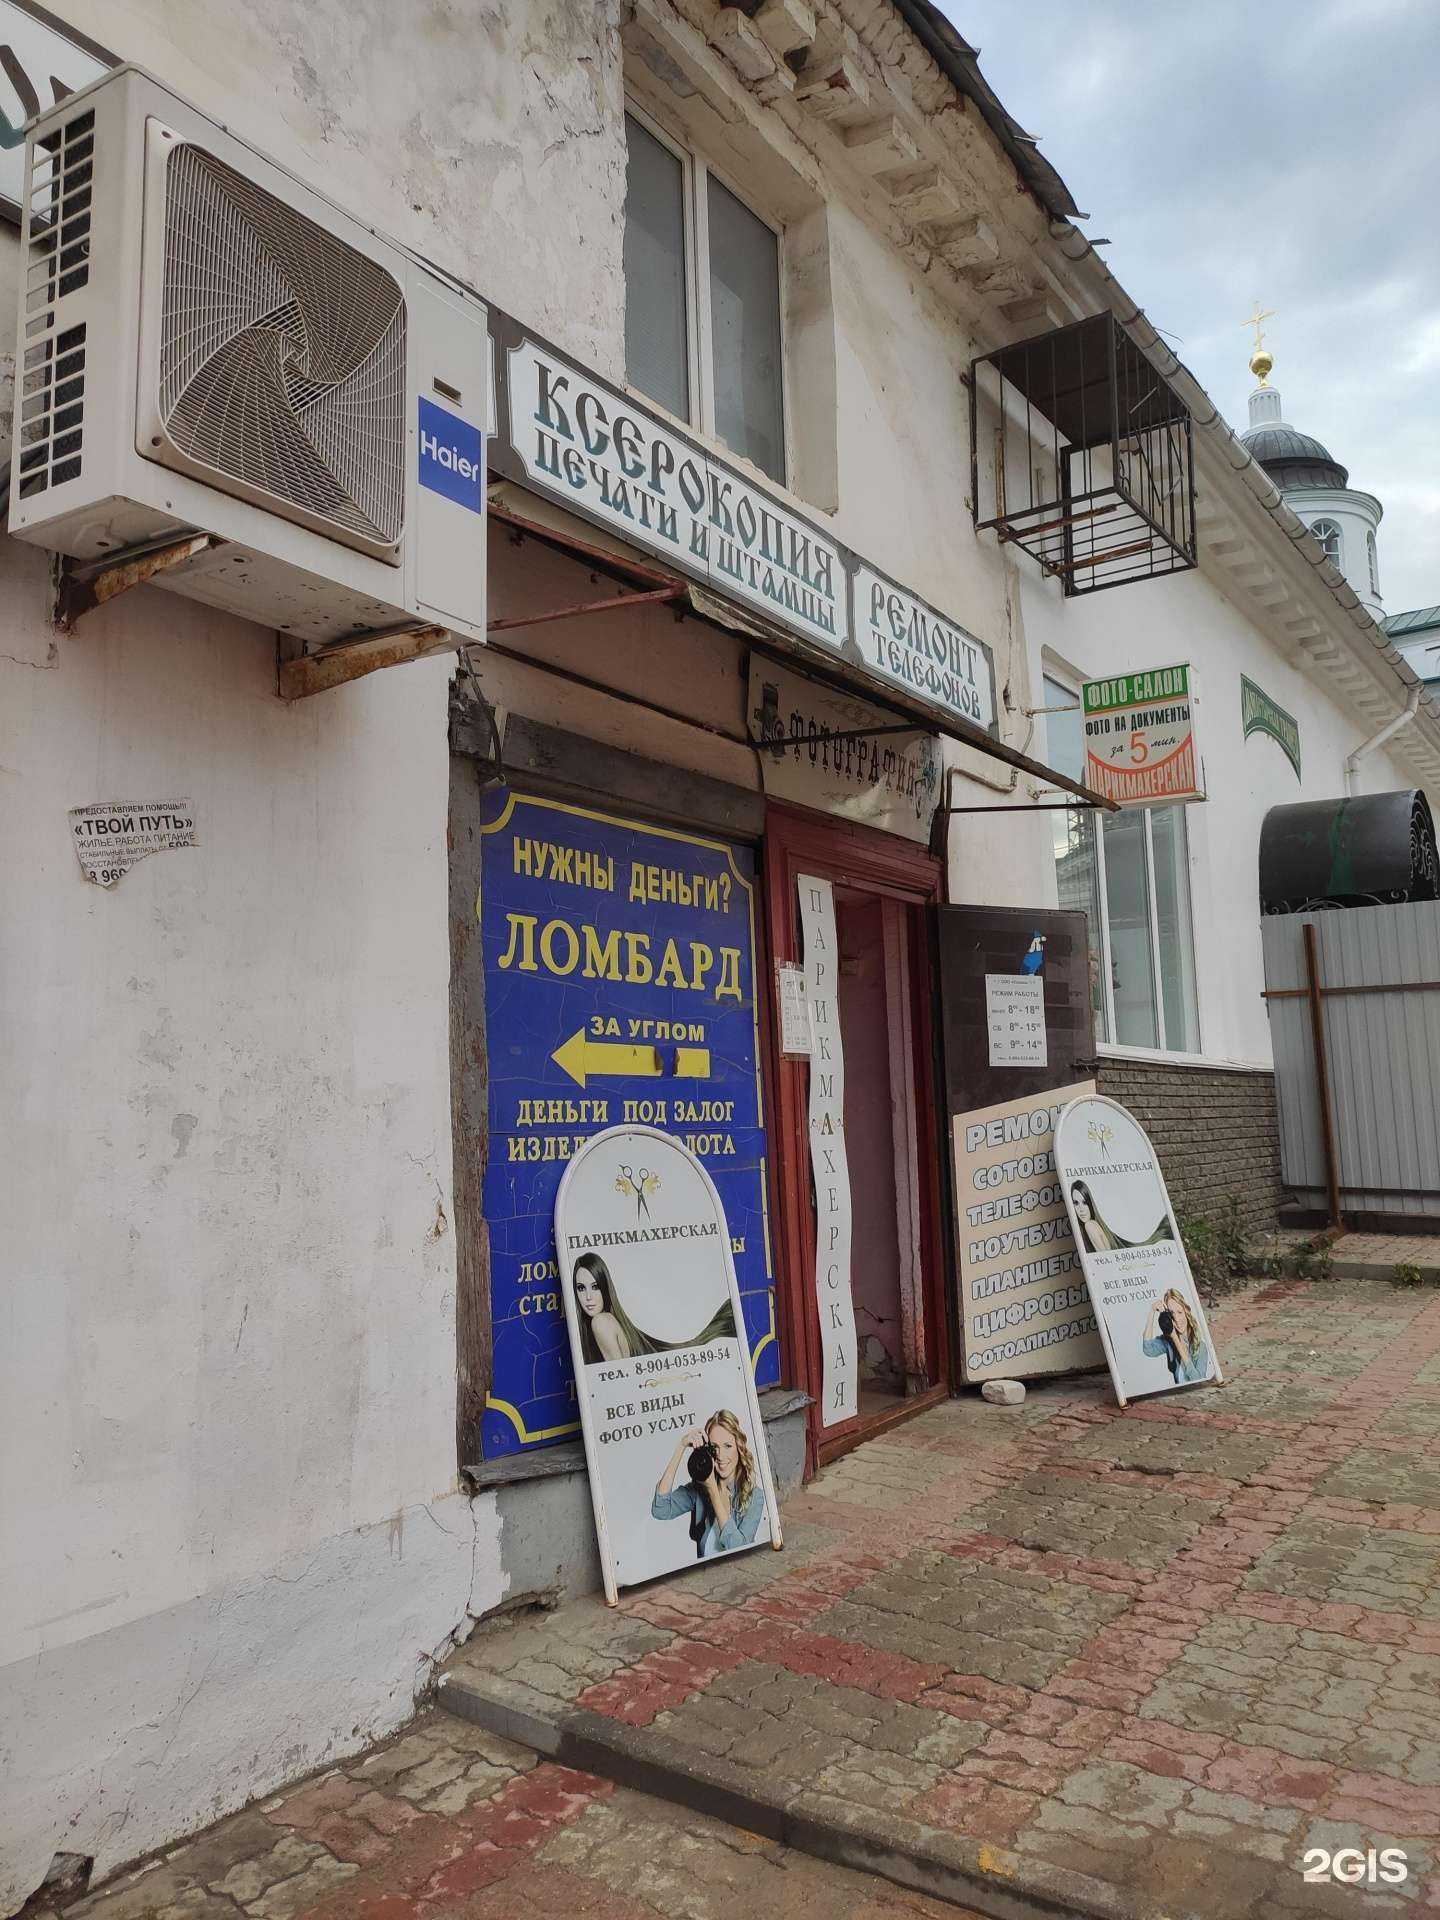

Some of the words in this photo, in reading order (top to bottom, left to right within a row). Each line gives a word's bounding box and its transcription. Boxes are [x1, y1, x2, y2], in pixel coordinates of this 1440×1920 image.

[420, 429, 479, 482] Haier
[533, 359, 835, 601] КСЕРОКОПИЯ
[535, 427, 680, 545] ПЕЧАТИ
[688, 517, 710, 562] И
[717, 535, 836, 636] ШТАМПЫ
[869, 582, 977, 687] РЕМОНТ
[871, 629, 981, 721] ТЕЛЕФОНОВ
[1087, 666, 1183, 708] ФОТО-САЛОН
[1085, 718, 1111, 736] ФОТО
[1114, 715, 1127, 732] НА
[1130, 703, 1191, 731] ДОКУМЕНТЫ
[1130, 731, 1149, 764] 5
[75, 814, 135, 836] «ТВОЙ
[139, 815, 193, 832] ПУТЬ»
[79, 837, 113, 849] ЖИЛЬЕ
[115, 834, 152, 846] РАБОТА
[154, 831, 196, 844] ПИТАНИЕ
[513, 836, 614, 892] НУЖНЫ
[629, 862, 732, 913] ДЕНЬГИ?
[498, 913, 743, 1002] ЛОМБАРД
[590, 1016, 621, 1036] ЗА
[629, 1019, 705, 1042] УГЛОМ
[516, 1099, 609, 1128] ДЕНЬГИ
[623, 1099, 667, 1126] ПОД
[673, 1100, 735, 1122] ЗАЛОГ
[673, 1133, 736, 1156] ЛОТА
[807, 888, 847, 1410] ПАРИКМАХЕРСКАЯ
[1064, 1161, 1154, 1178] ПАРИКМАХЕРСКАЯ
[567, 1222, 719, 1249] ПАРИКМАХЕРСКАЯ
[1102, 1293, 1128, 1306] ФОТО
[1128, 1288, 1158, 1301] УСЛУГ
[1103, 1279, 1121, 1291] ВСЕ
[1122, 1275, 1149, 1288] ВИДЫ
[598, 1370, 630, 1383] тел.
[634, 1347, 731, 1375] 8-904-053-89-54
[605, 1401, 636, 1420] ВСЕ
[641, 1393, 686, 1414] ВИДЫ
[599, 1423, 644, 1445] ФОТО
[648, 1411, 697, 1434] УСЛУГ
